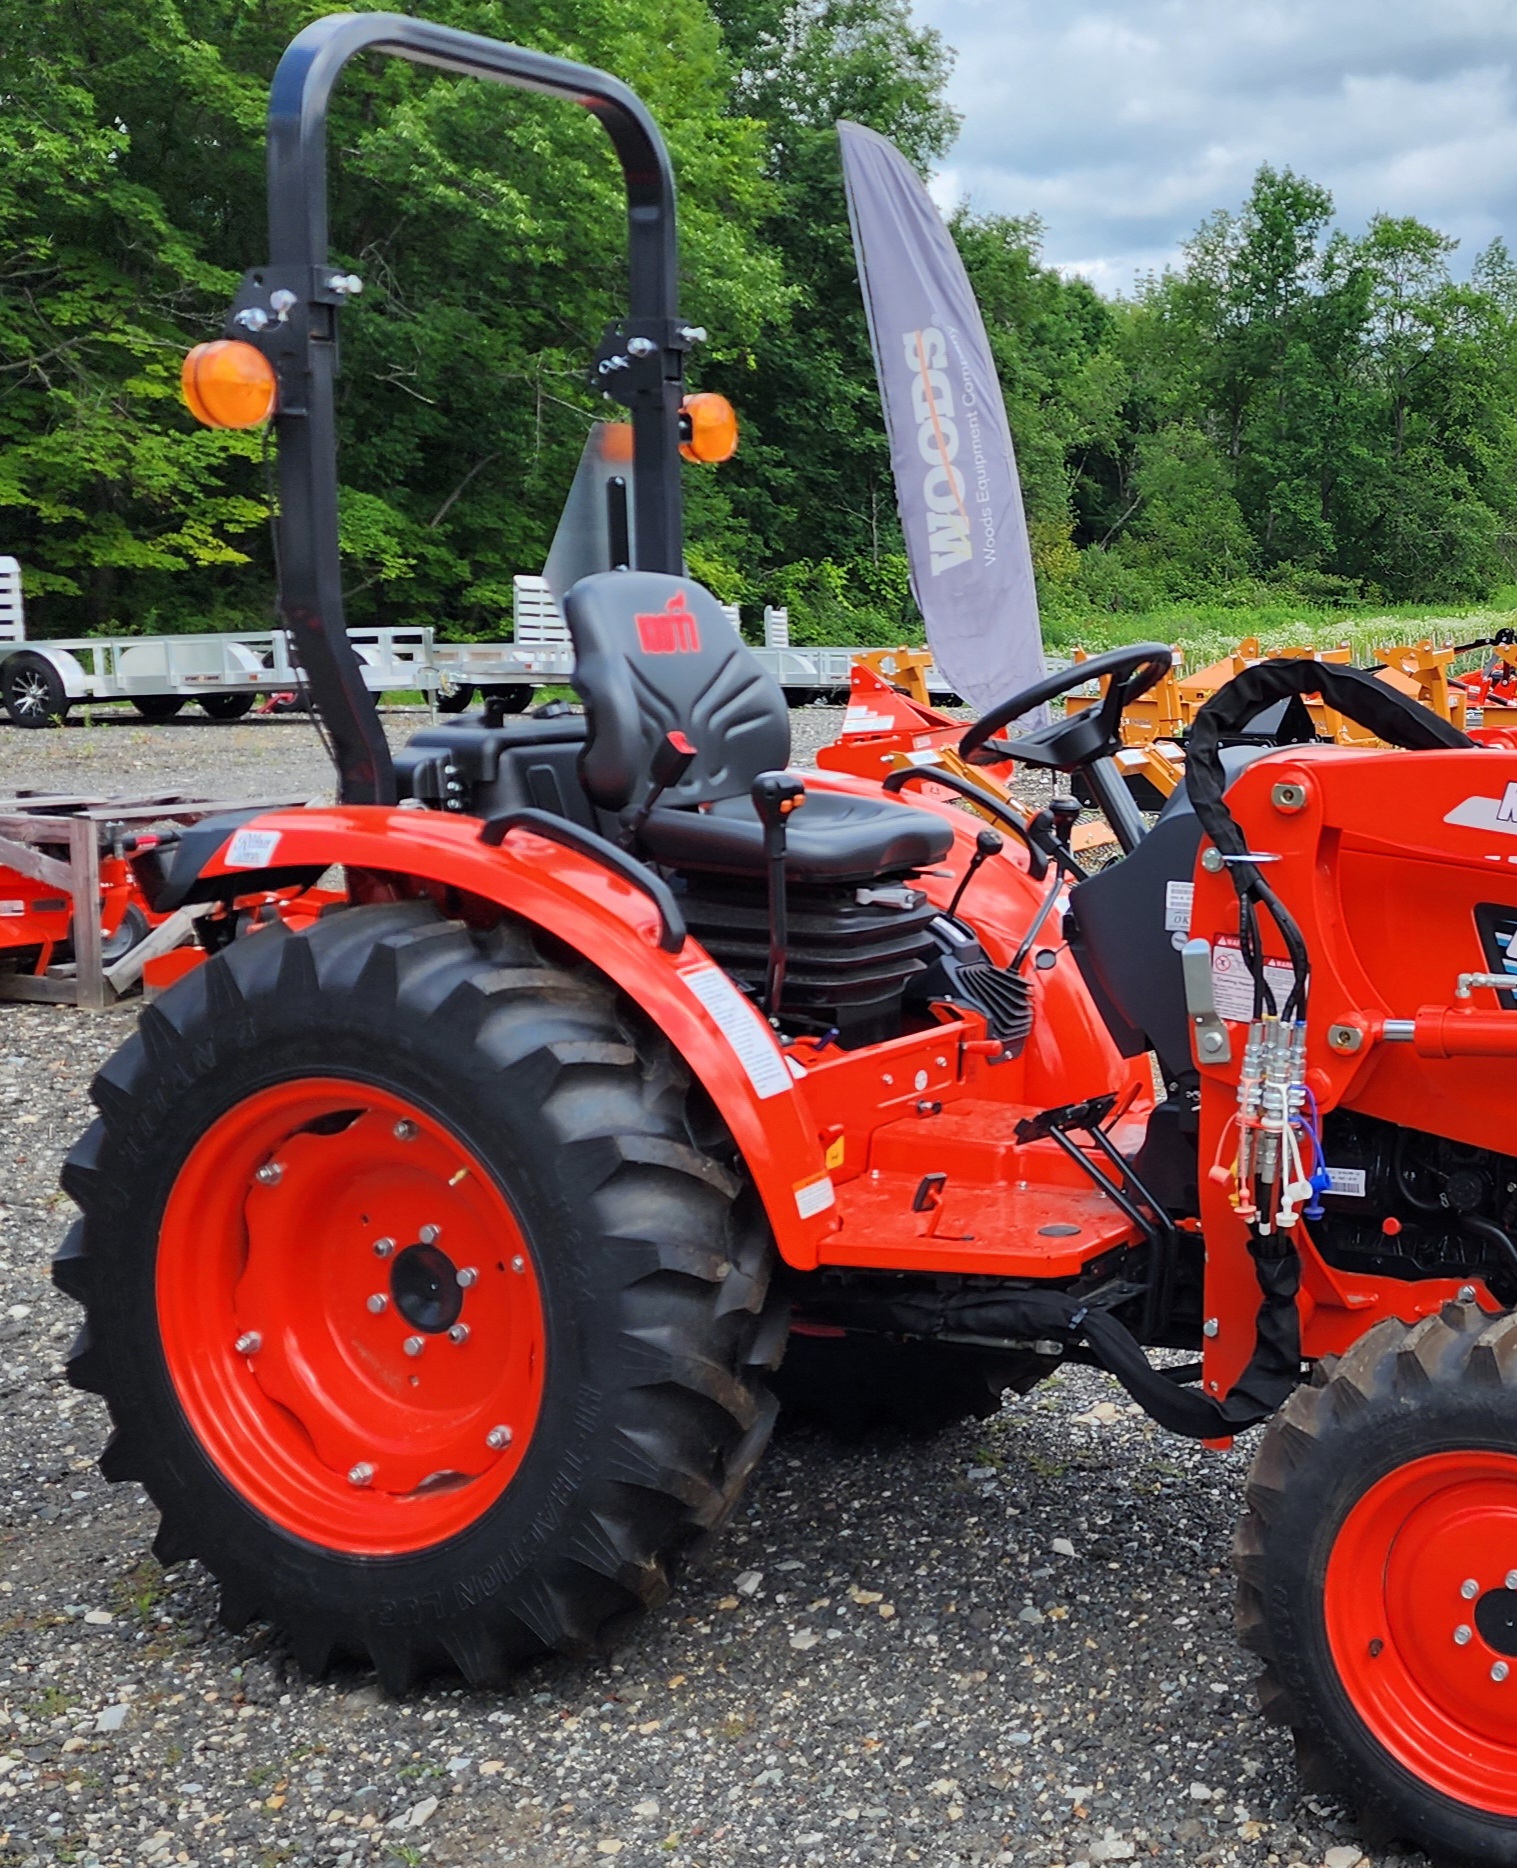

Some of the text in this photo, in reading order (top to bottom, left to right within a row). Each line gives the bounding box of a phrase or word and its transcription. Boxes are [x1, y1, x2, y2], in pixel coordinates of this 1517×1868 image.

[903, 326, 972, 576] WOODS
[966, 410, 990, 503] Equipment
[978, 506, 996, 567] Woods
